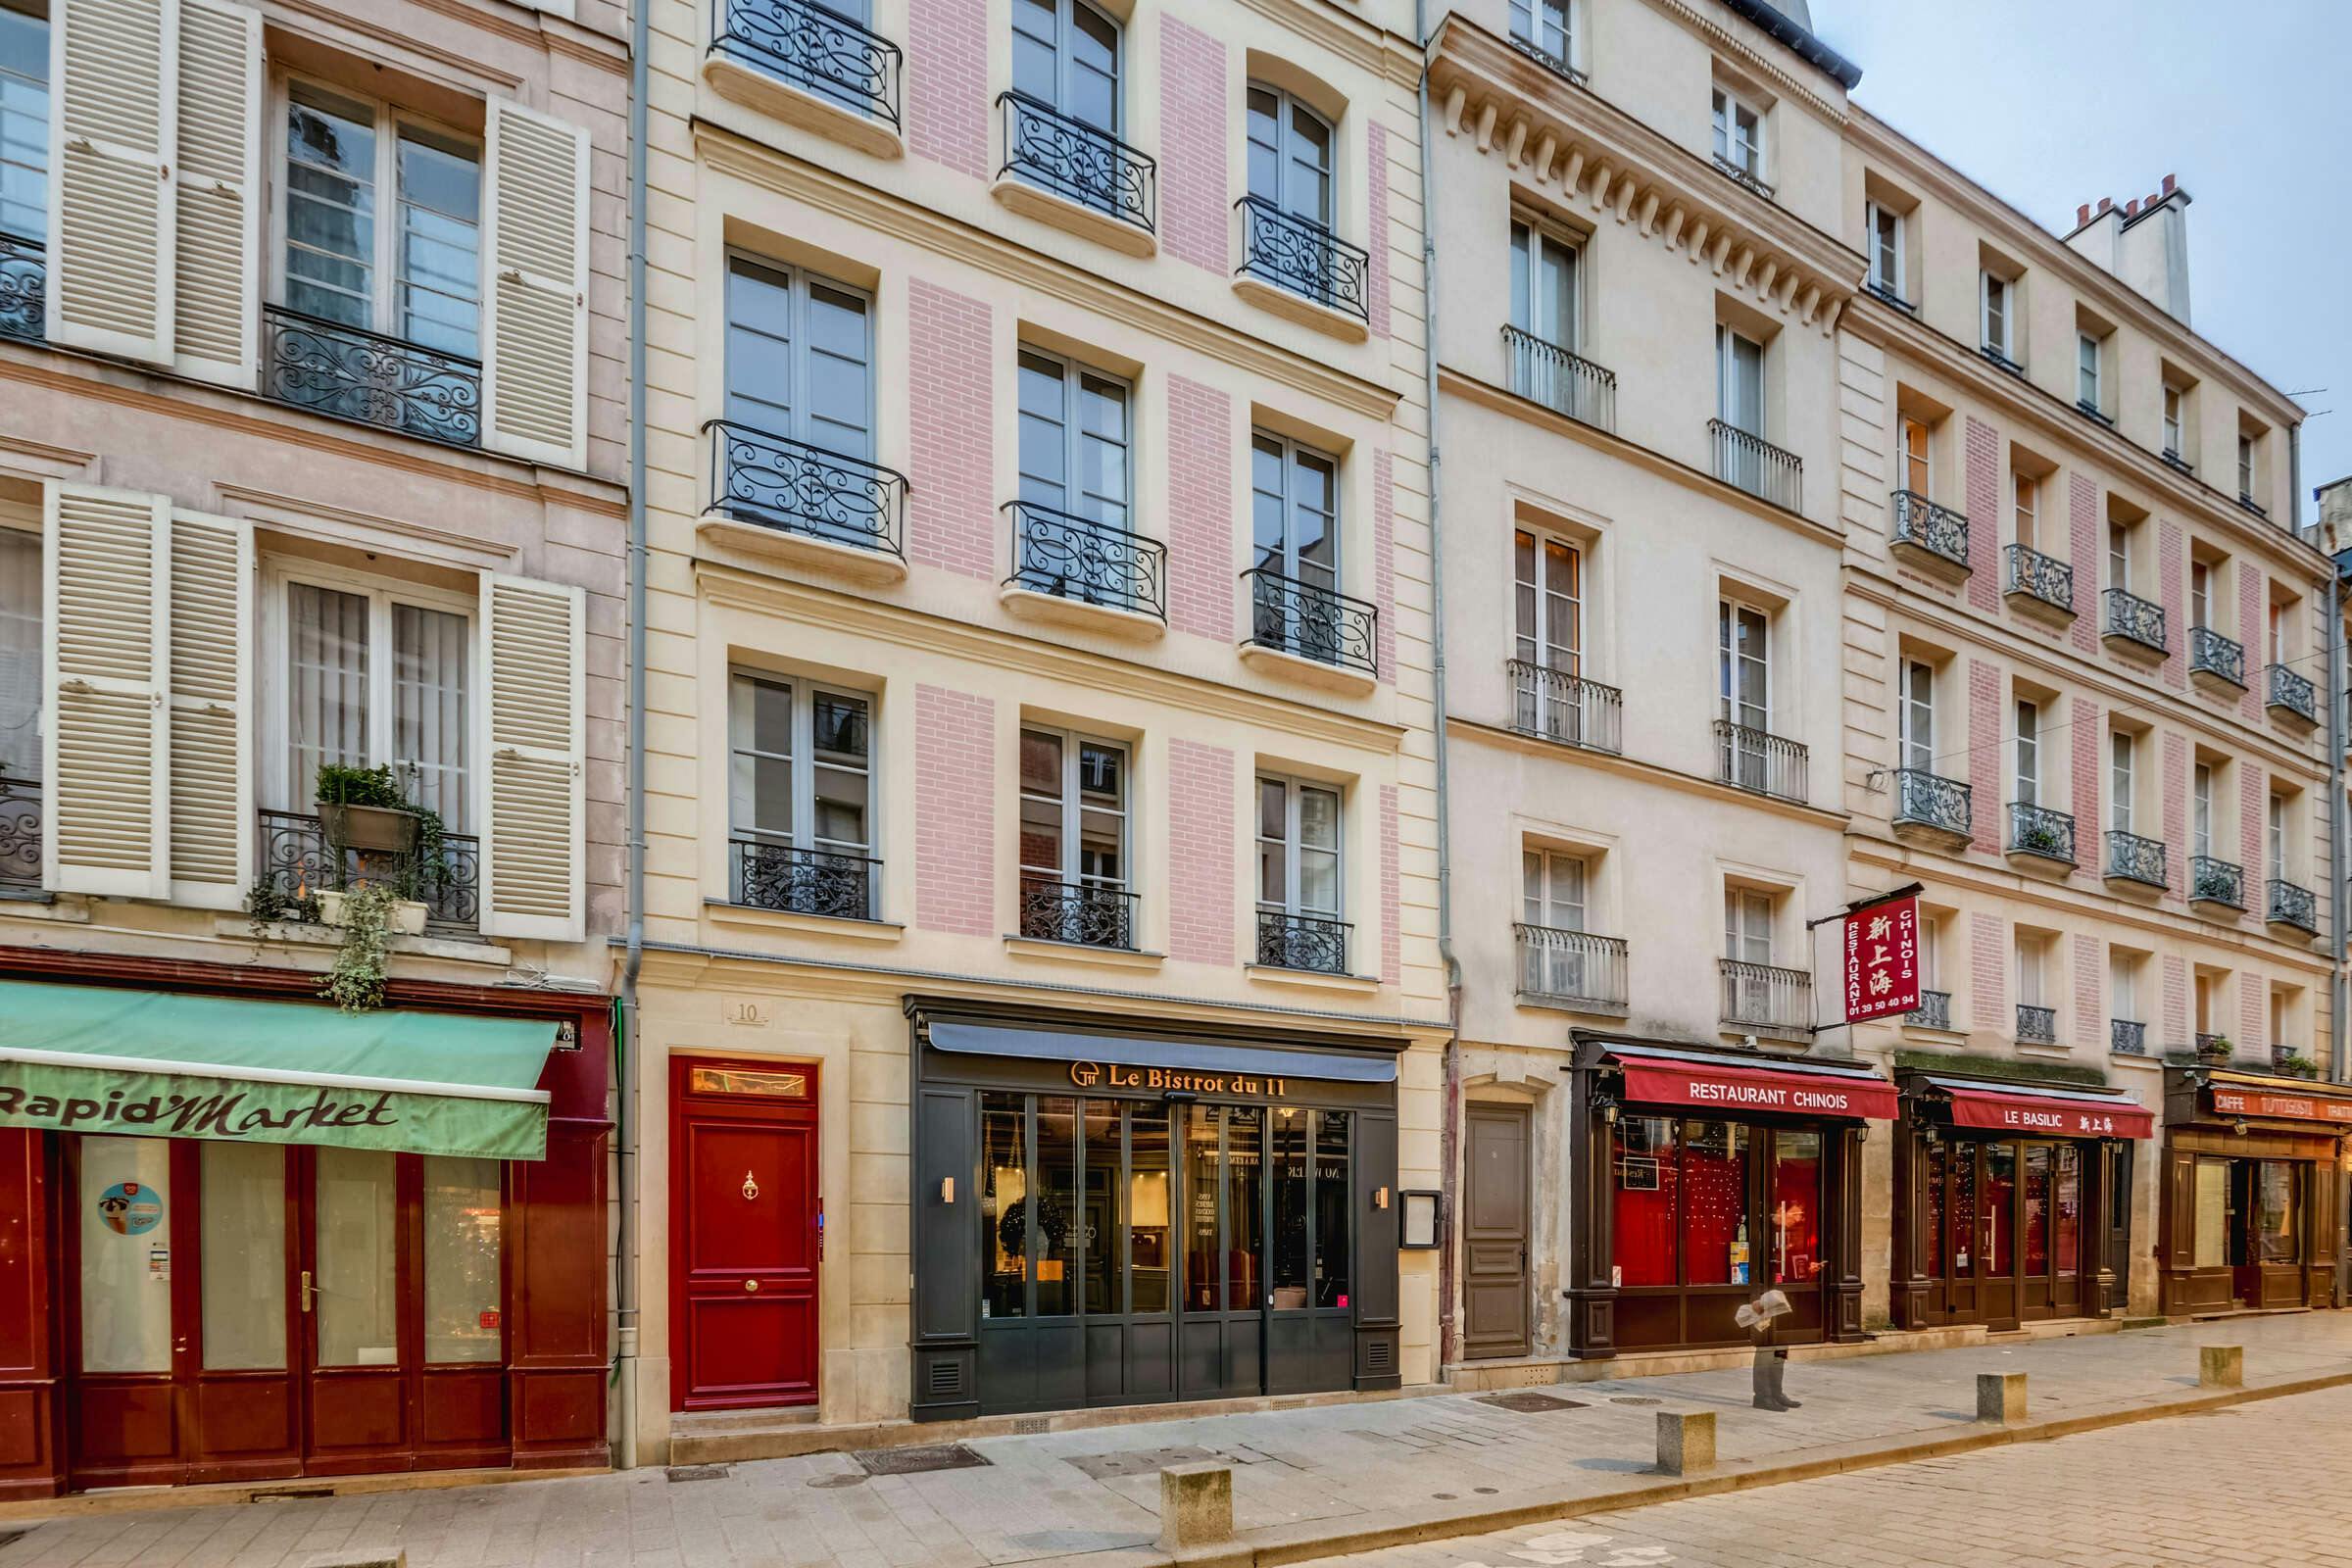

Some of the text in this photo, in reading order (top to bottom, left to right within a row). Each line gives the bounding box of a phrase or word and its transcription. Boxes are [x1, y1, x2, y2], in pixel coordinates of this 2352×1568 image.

[1866, 915, 1892, 996] 新上海
[1899, 909, 1913, 979] CHINOIS
[1848, 921, 1860, 1005] RESTAURANT
[738, 1004, 757, 1020] 10
[1849, 995, 1914, 1016] 01 39 50 40 94
[1108, 1064, 1285, 1096] Le Bistrot du 11
[1690, 1082, 1848, 1109] RESTAURANT CHINOIS
[2005, 1110, 2062, 1127] LE BASILIC
